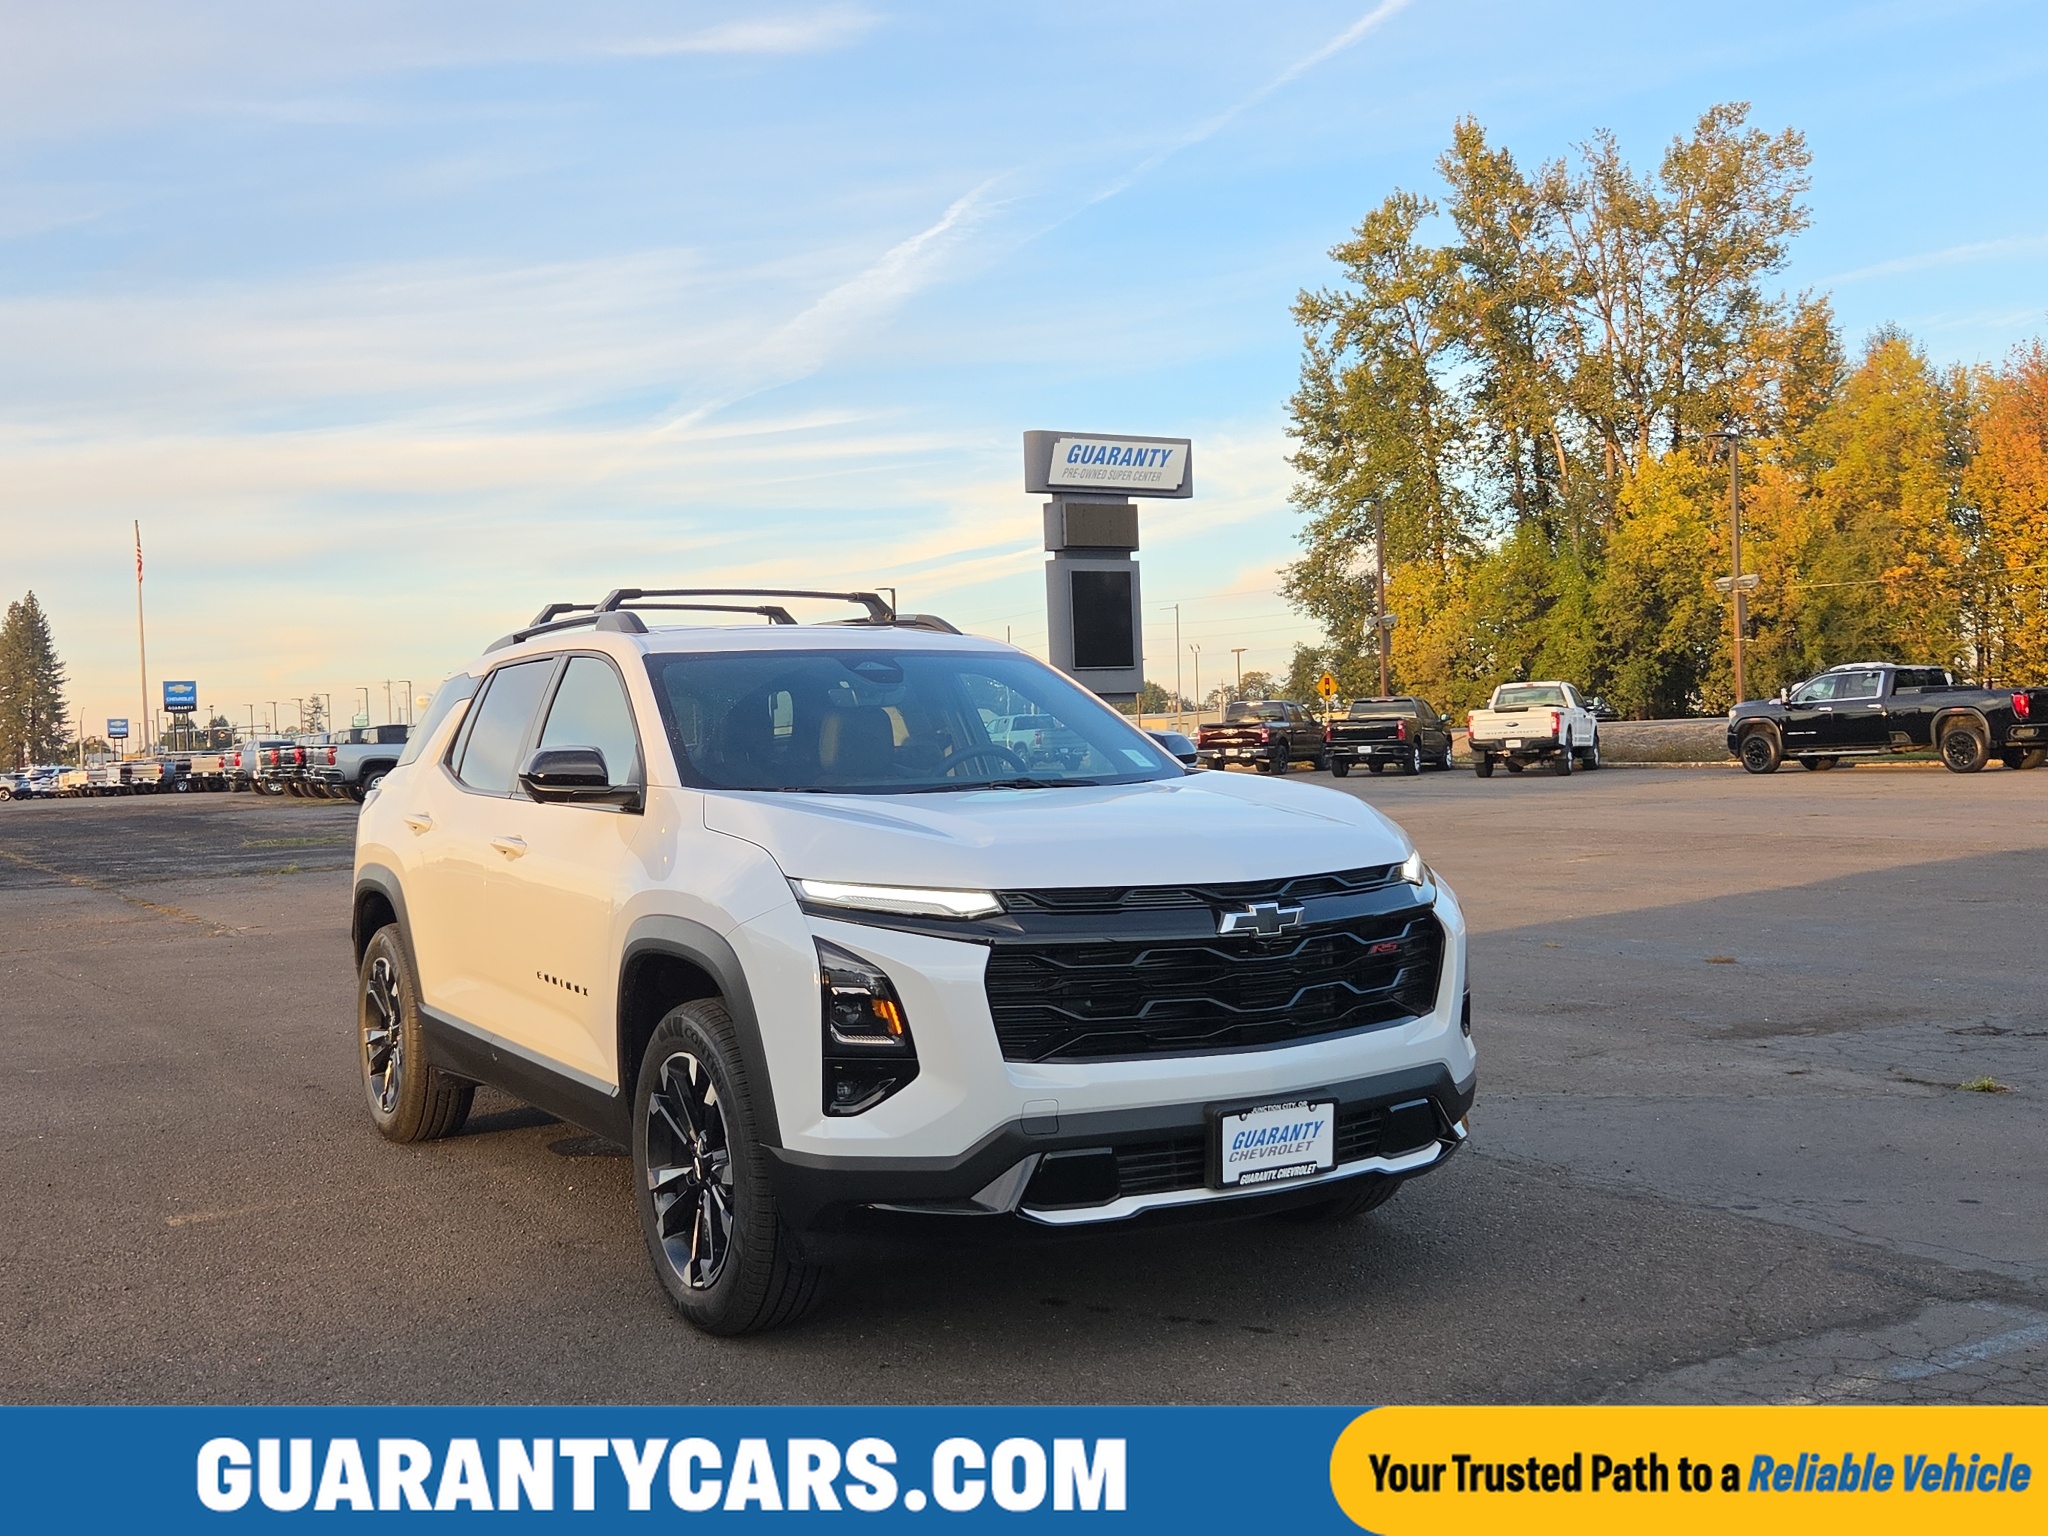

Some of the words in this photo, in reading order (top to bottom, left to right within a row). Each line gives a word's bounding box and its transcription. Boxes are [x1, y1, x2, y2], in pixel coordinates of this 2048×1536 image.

[1066, 444, 1173, 468] GUARANTY
[1061, 467, 1107, 480] PRE-OWNED
[1108, 469, 1132, 481] SUPER
[1133, 471, 1162, 482] CENTER
[1232, 1120, 1324, 1150] GUARANTY
[1229, 1140, 1314, 1162] CHEVROLET
[1277, 1163, 1317, 1179] CHEVROLET
